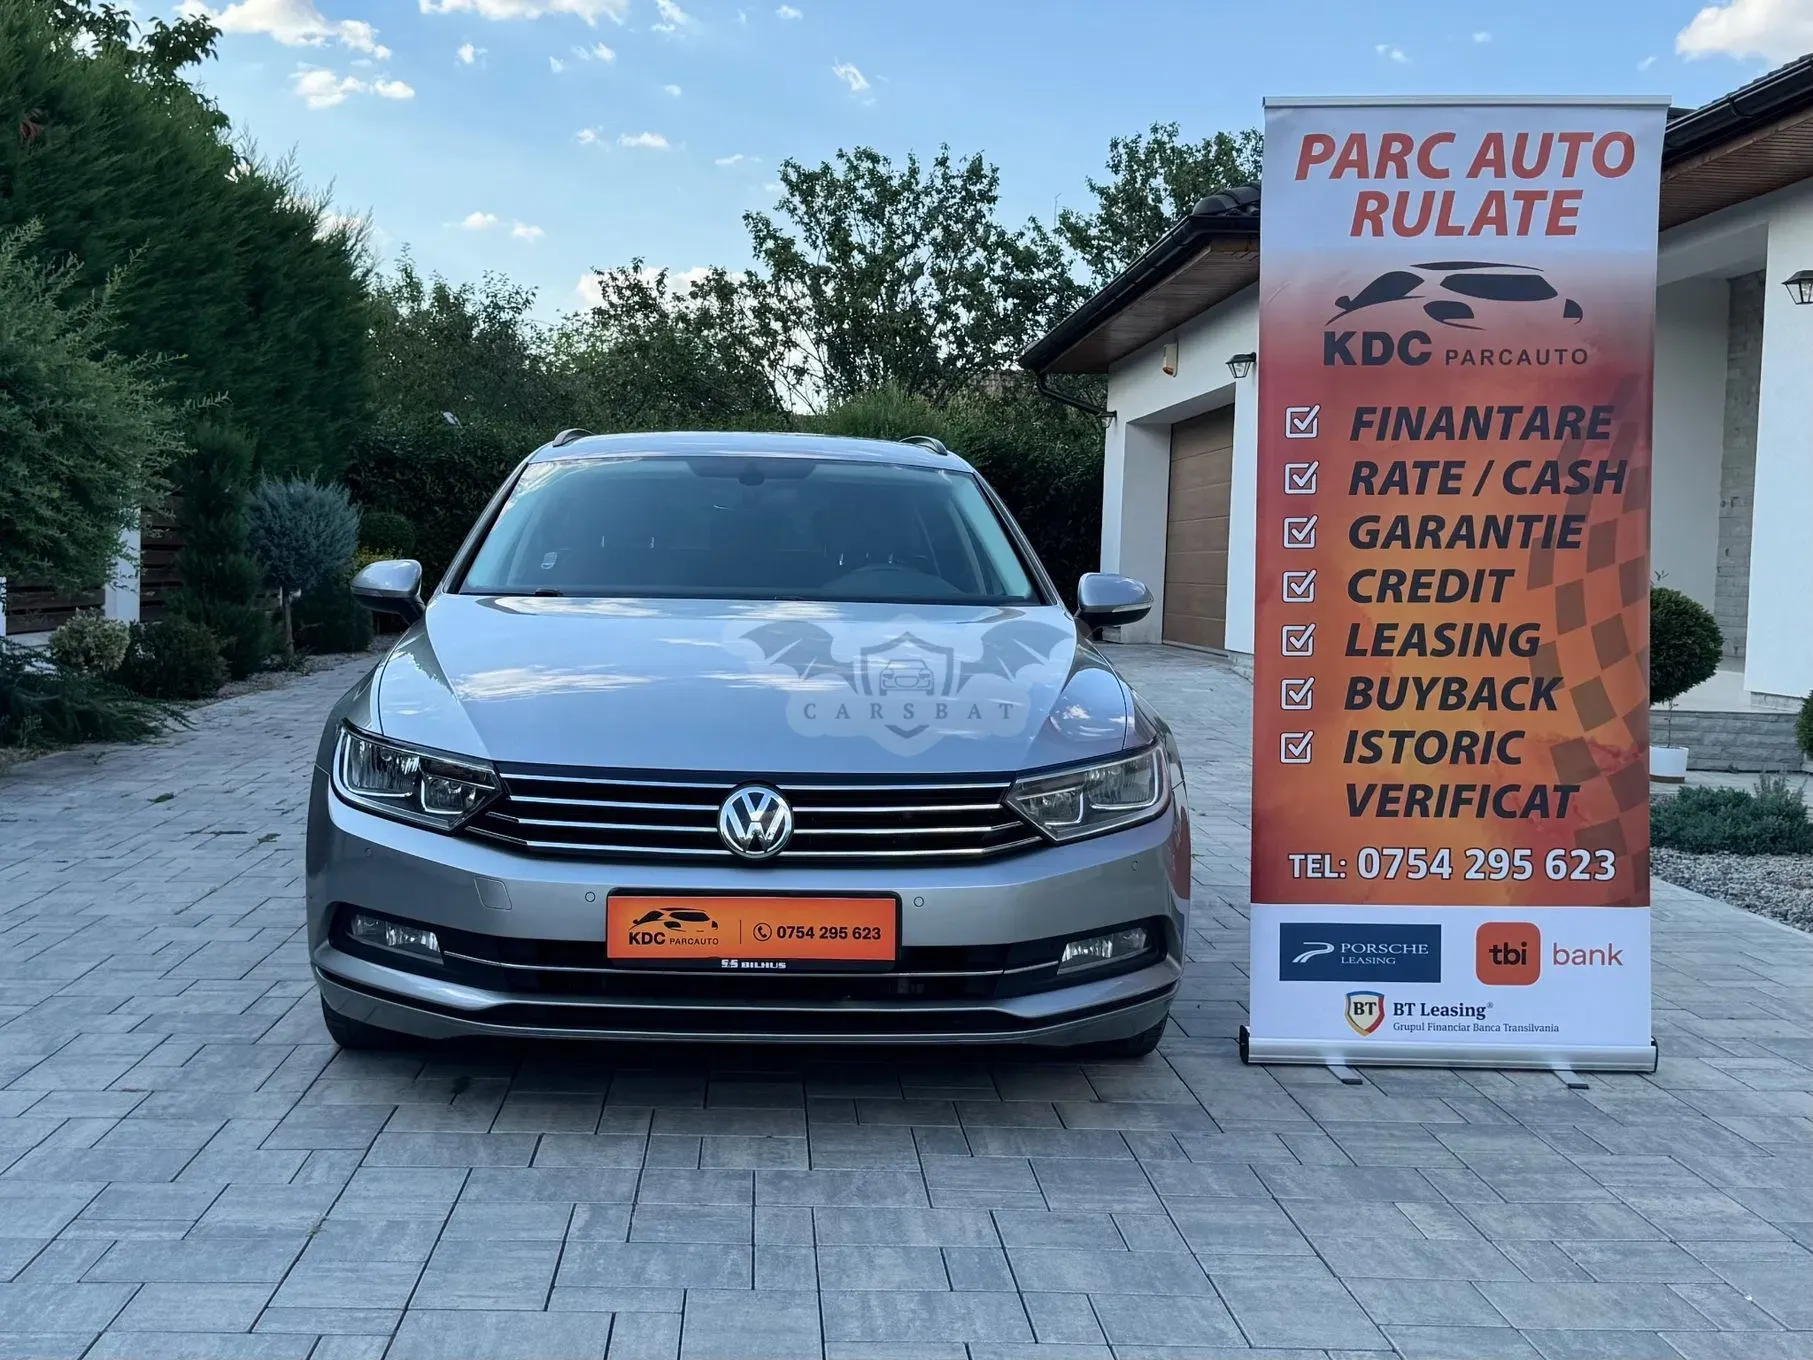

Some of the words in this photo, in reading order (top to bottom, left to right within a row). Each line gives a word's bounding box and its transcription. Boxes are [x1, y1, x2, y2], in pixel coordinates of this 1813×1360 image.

[1294, 131, 1457, 181] PARC
[1465, 130, 1636, 180] AUTO
[1349, 189, 1584, 238] RULATE
[1323, 330, 1433, 367] KDC
[1445, 348, 1588, 366] PARCAUTO
[1349, 404, 1615, 441] FINANTARE
[1347, 460, 1466, 496] RATE
[1502, 459, 1628, 496] CASH
[1347, 513, 1586, 550] GARANTIE
[1347, 568, 1515, 604] CREDIT
[1344, 622, 1541, 658] LEASING
[1343, 675, 1564, 711] BUYBACK
[1343, 729, 1525, 765] ISTORIC
[1345, 783, 1580, 819] VERIFICAT
[1288, 853, 1347, 879] TEL:
[1357, 847, 1452, 880] 0754
[1464, 848, 1533, 881] 295
[1545, 849, 1616, 881] 623
[628, 931, 666, 945] KDC
[669, 938, 719, 946] PARCAUTO
[776, 926, 815, 939] 0754
[819, 926, 848, 940] 295
[852, 926, 881, 940] 623
[1340, 943, 1428, 955] PORSCHE
[1340, 956, 1396, 965] LEASING
[1488, 941, 1528, 966] tbi
[1553, 942, 1623, 966] bank
[1353, 1001, 1377, 1016] BT
[1393, 1002, 1416, 1017] BT
[1393, 1022, 1425, 1033] Grupul
[1427, 1022, 1470, 1033] Financiar
[1472, 1023, 1501, 1033] Banca
[1503, 1023, 1560, 1033] Transilvania
